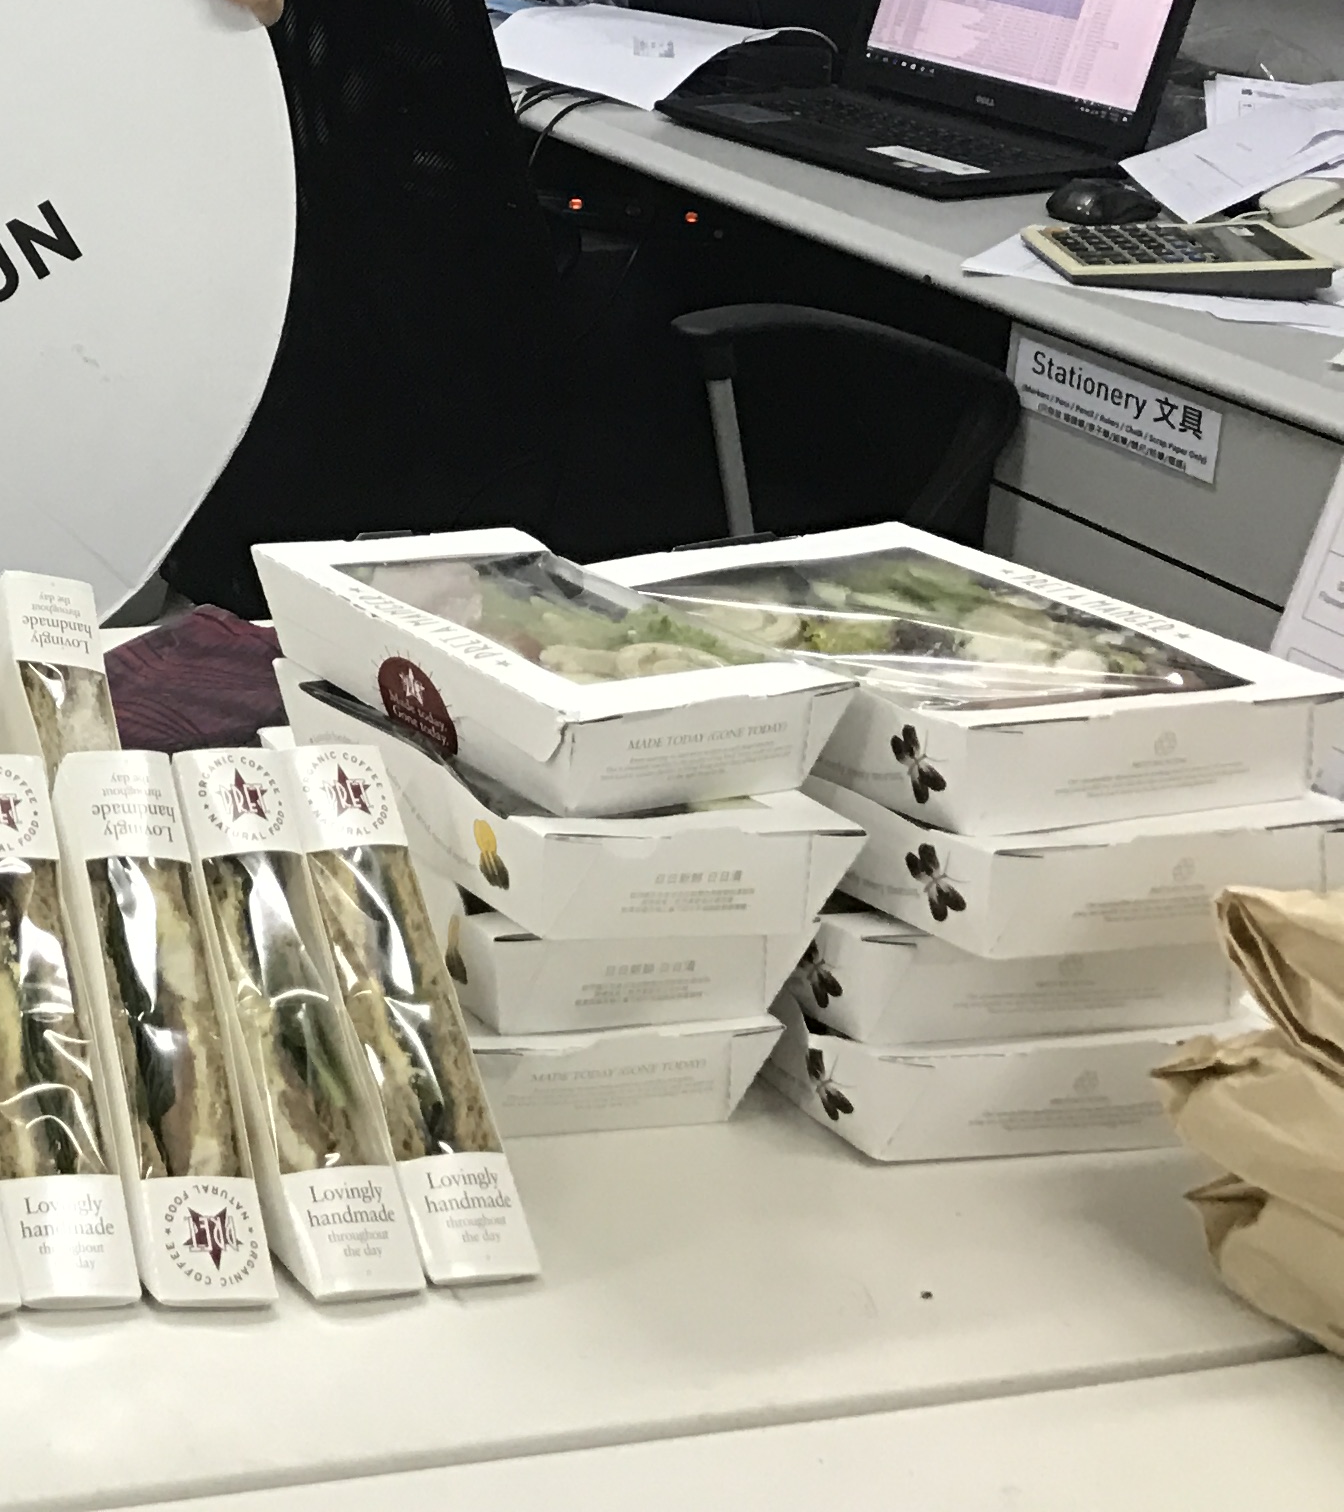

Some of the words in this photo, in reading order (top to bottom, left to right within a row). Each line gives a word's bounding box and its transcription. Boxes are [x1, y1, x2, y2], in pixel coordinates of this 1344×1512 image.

[1032, 350, 1147, 420] Stationery
[1153, 396, 1204, 441] 文具
[22, 615, 92, 638] handmade
[31, 630, 90, 654] Lovingly
[627, 736, 662, 751] MADE
[667, 733, 704, 746] TODAY
[221, 782, 270, 814] PRET
[323, 778, 372, 809] PRET
[18, 819, 40, 847] FOOD
[426, 1167, 499, 1190] Lovingly
[310, 1180, 383, 1204] Lovingly
[424, 1189, 512, 1214] handmade
[307, 1204, 396, 1228] handmade
[188, 1215, 240, 1254] PRET
[328, 1228, 388, 1243] throughout
[343, 1244, 361, 1257] the
[363, 1243, 383, 1258] day
